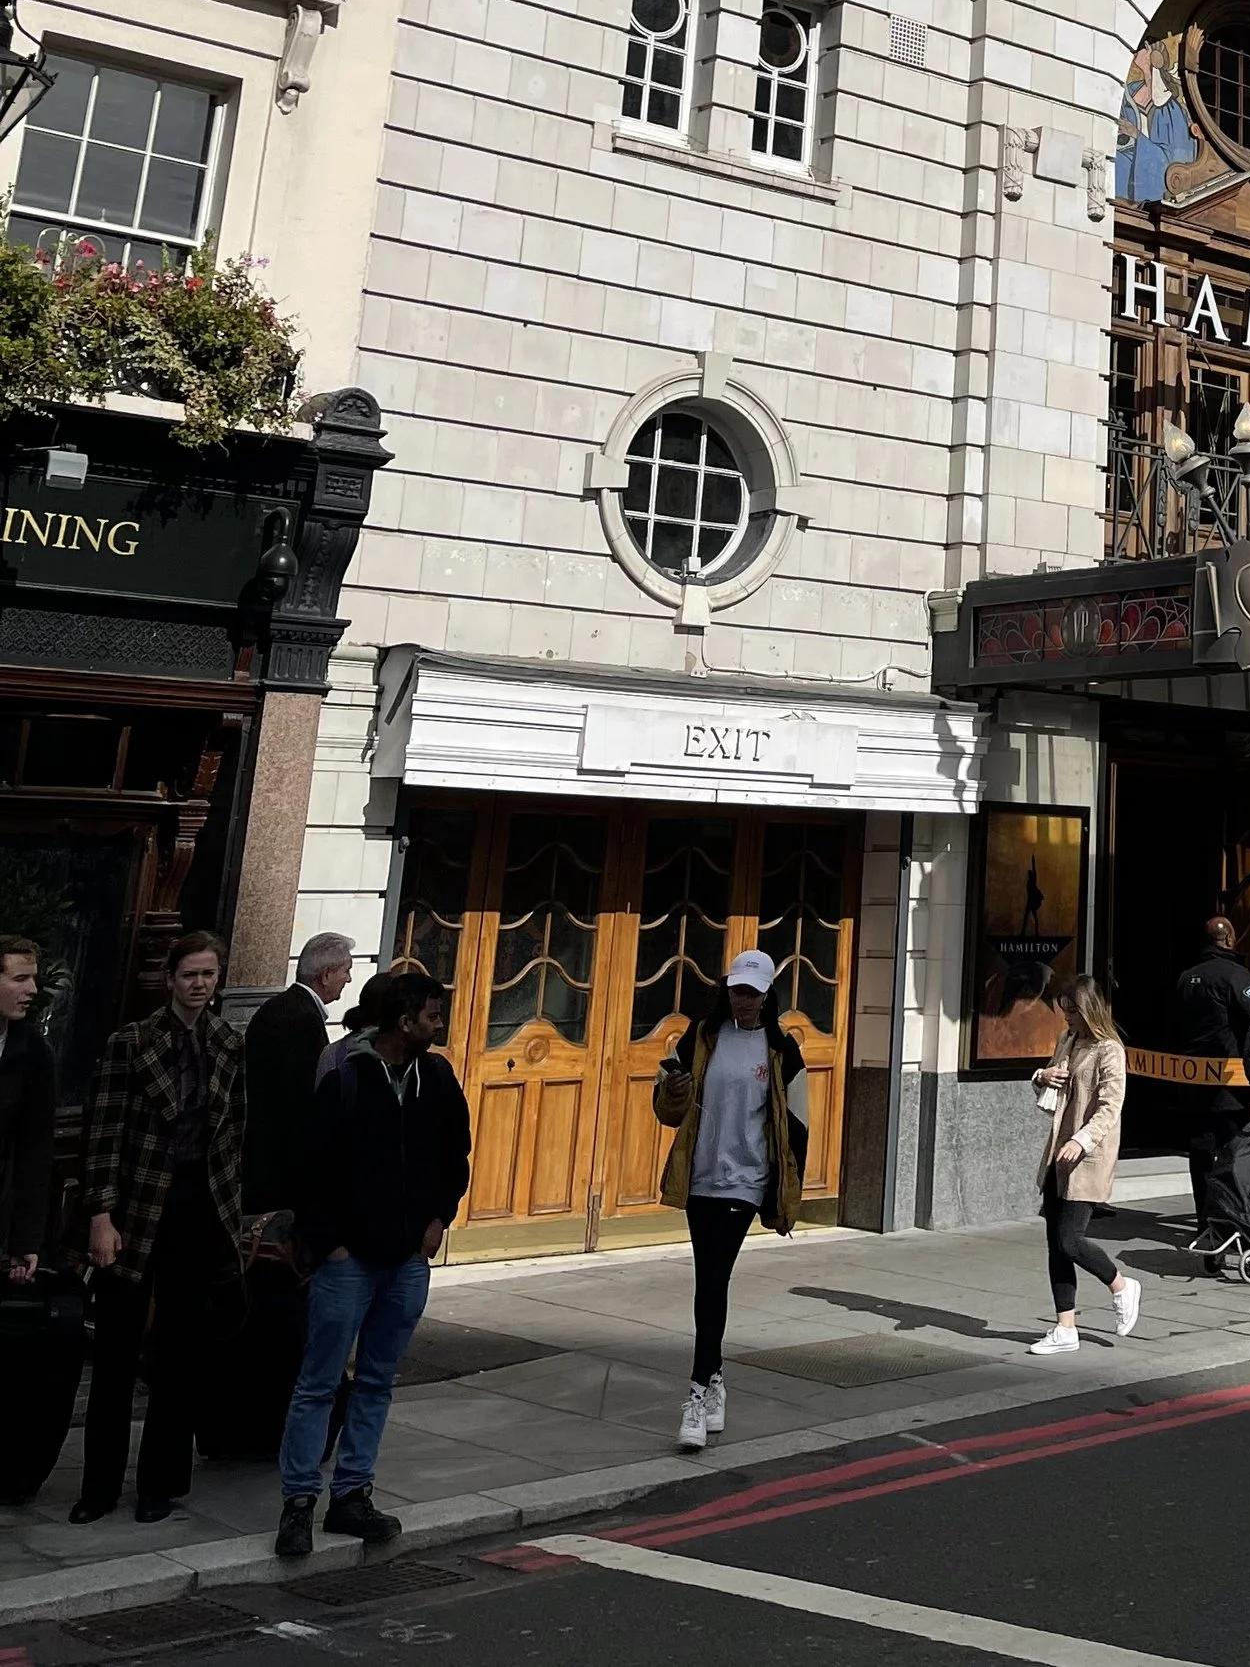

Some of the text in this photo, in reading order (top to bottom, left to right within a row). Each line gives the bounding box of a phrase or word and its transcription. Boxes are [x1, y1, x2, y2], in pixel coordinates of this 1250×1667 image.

[0, 507, 140, 556] INING
[684, 725, 771, 762] EXIT
[999, 942, 1059, 953] HAMILTON
